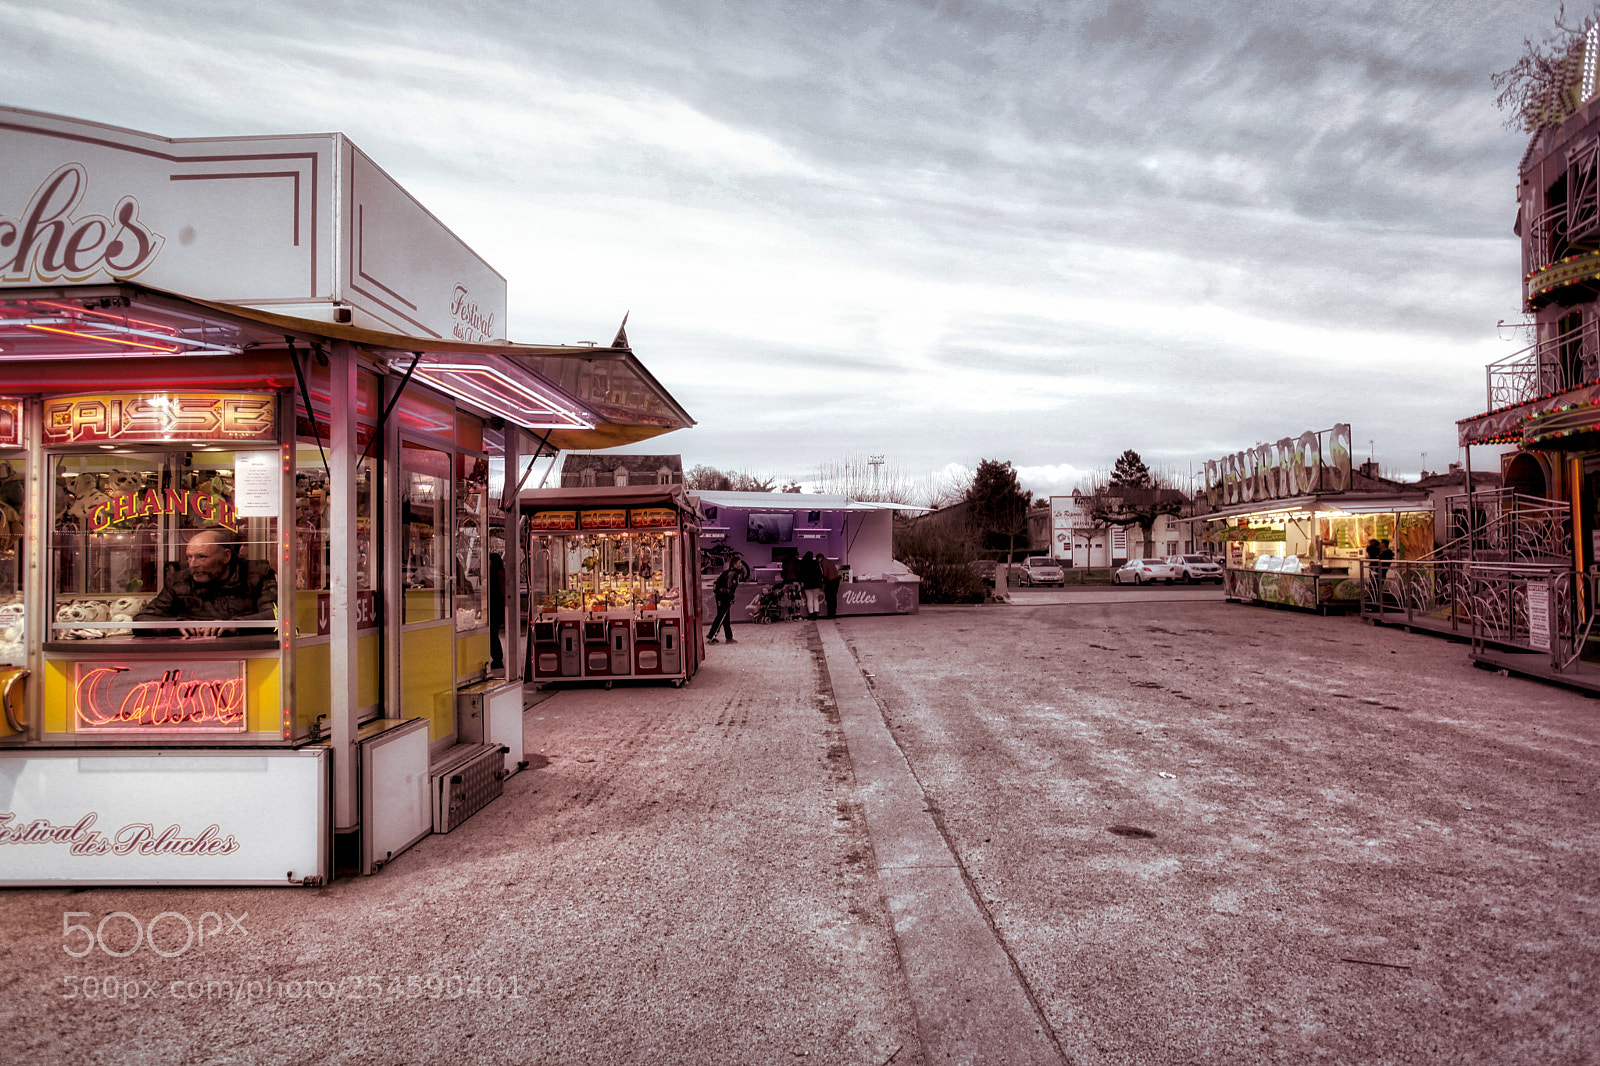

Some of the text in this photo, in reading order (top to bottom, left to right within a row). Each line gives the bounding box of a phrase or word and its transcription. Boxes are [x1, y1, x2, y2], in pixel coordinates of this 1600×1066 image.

[450, 284, 495, 339] Festival
[45, 398, 271, 441] CAISSE
[1206, 422, 1350, 506] CHURROS
[88, 489, 239, 534] CHANGE
[842, 590, 877, 604] Villes
[71, 824, 239, 855] des Peluches
